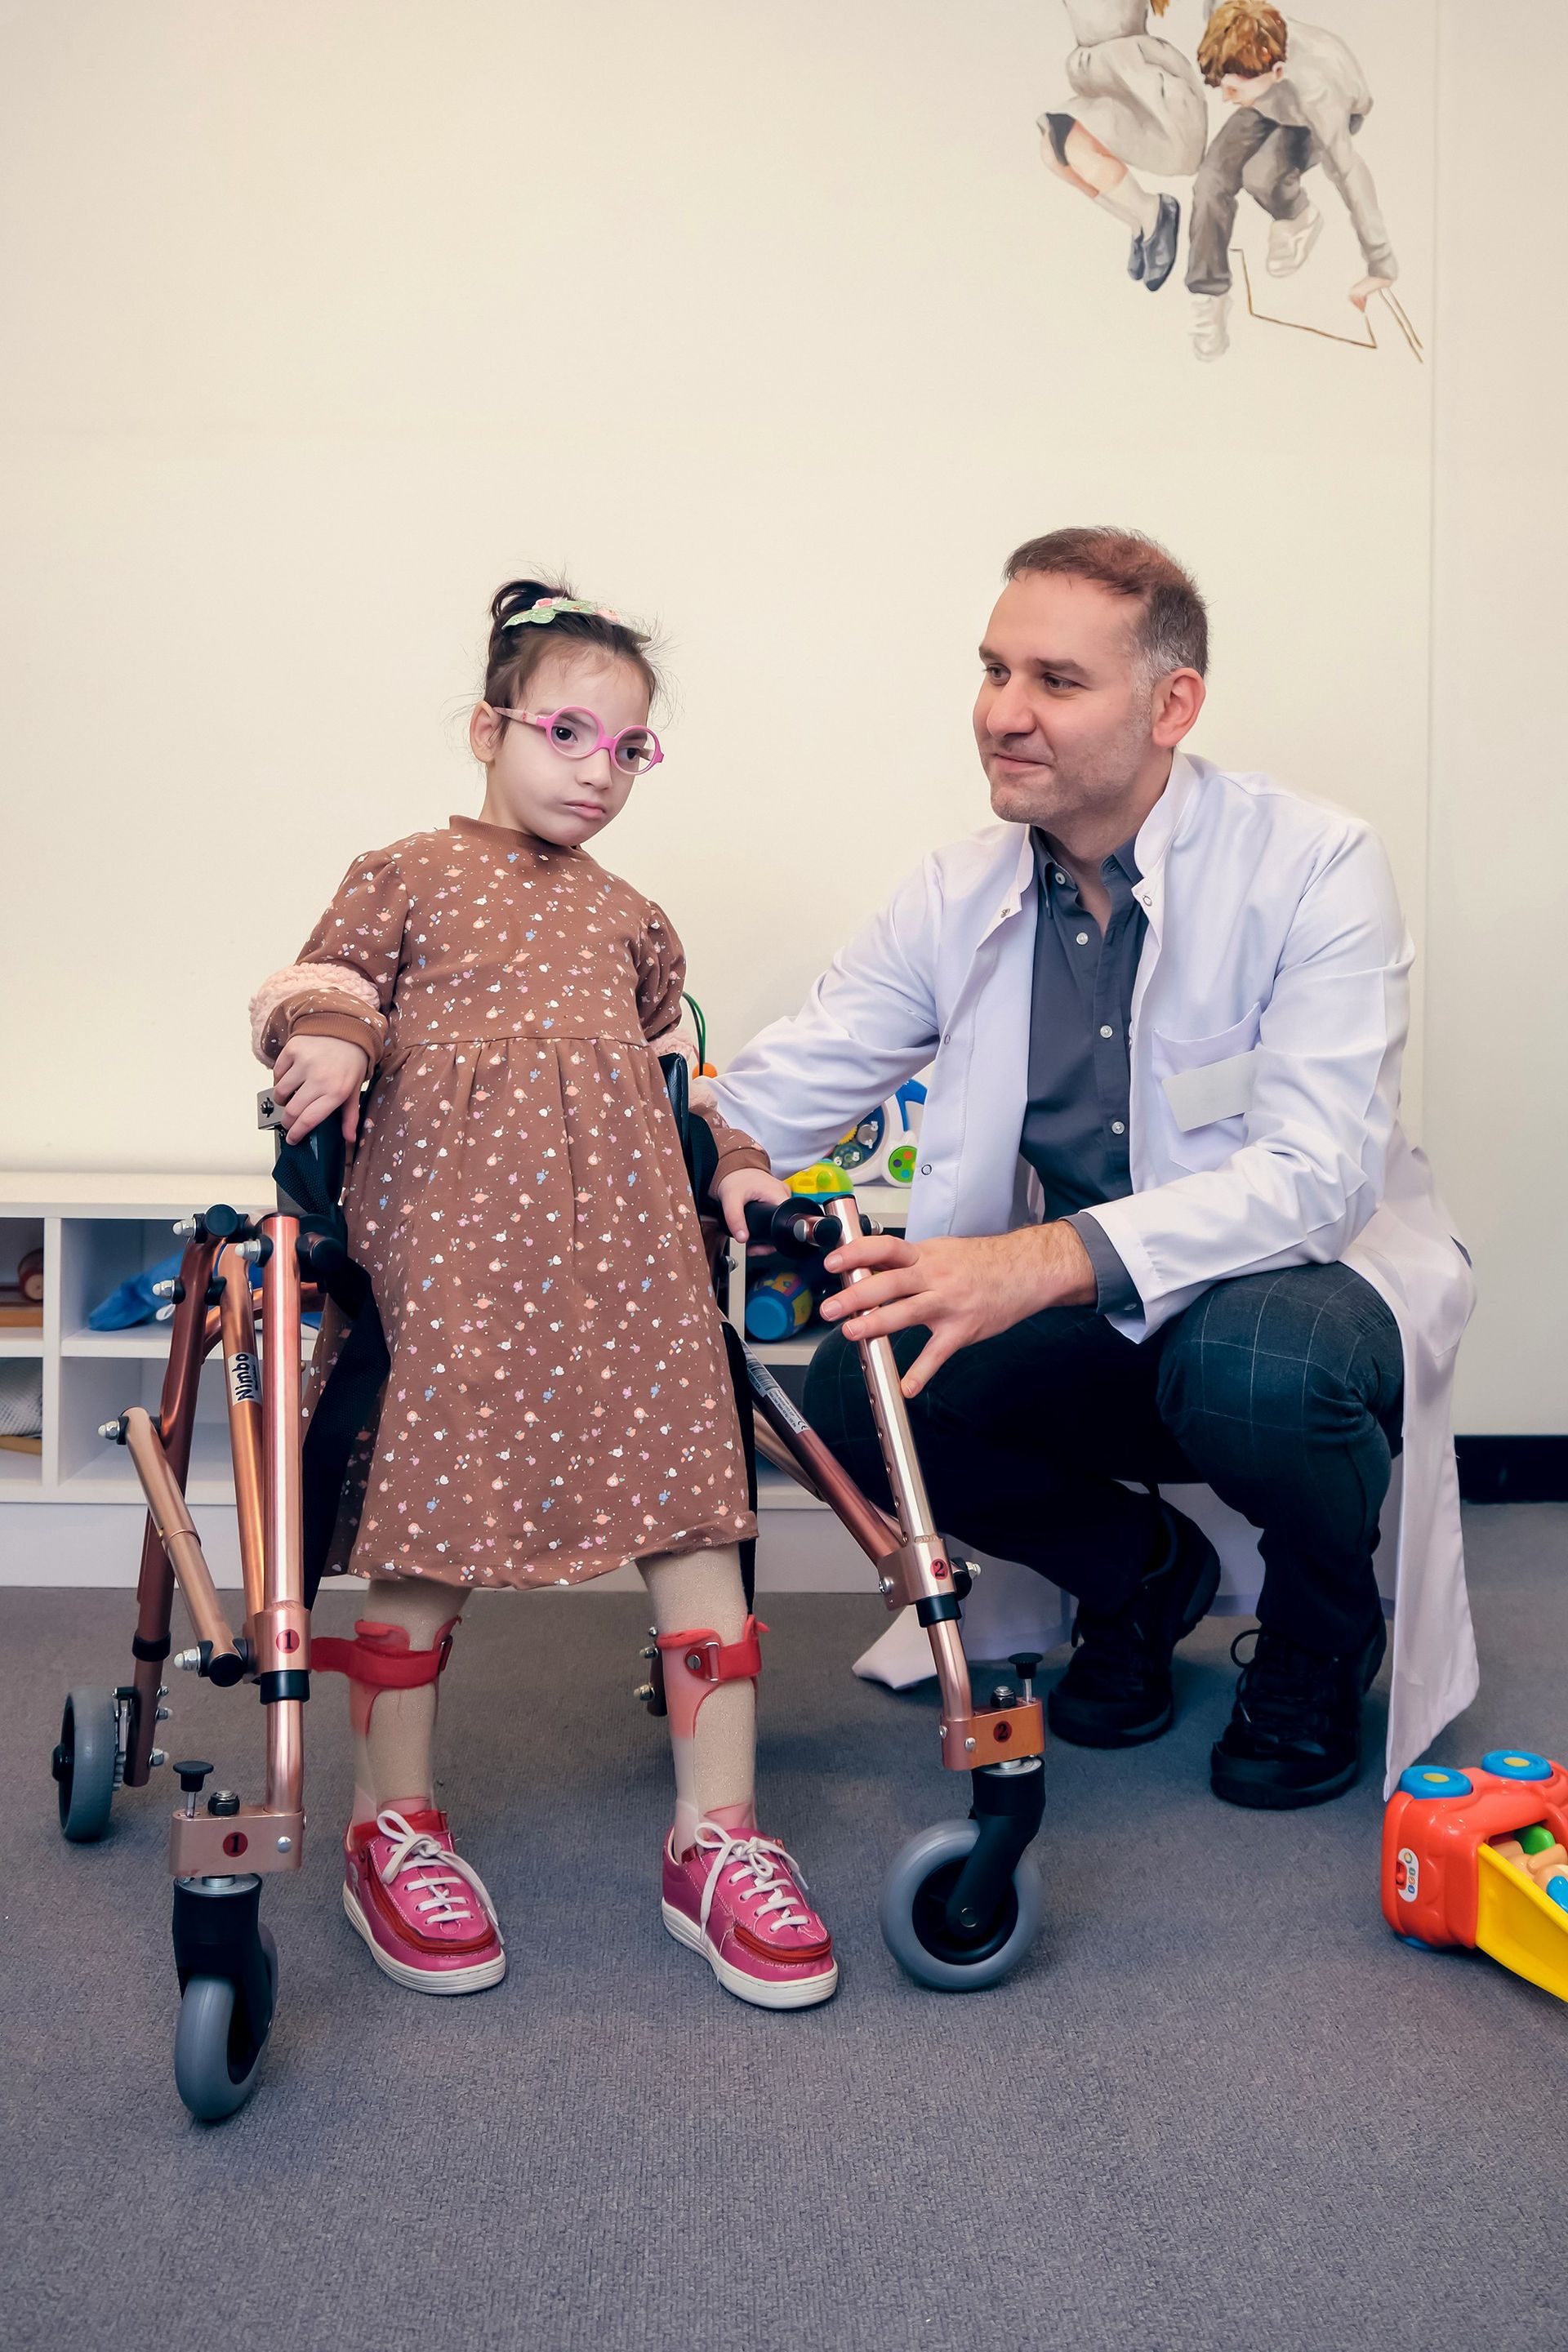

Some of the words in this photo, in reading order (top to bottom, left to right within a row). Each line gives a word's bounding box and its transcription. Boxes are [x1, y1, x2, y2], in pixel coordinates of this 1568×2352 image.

[232, 1353, 255, 1401] Nimbo
[934, 1561, 945, 1577] 2
[285, 1631, 294, 1649] 1
[997, 1723, 1009, 1740] 2
[231, 1834, 240, 1853] 1
